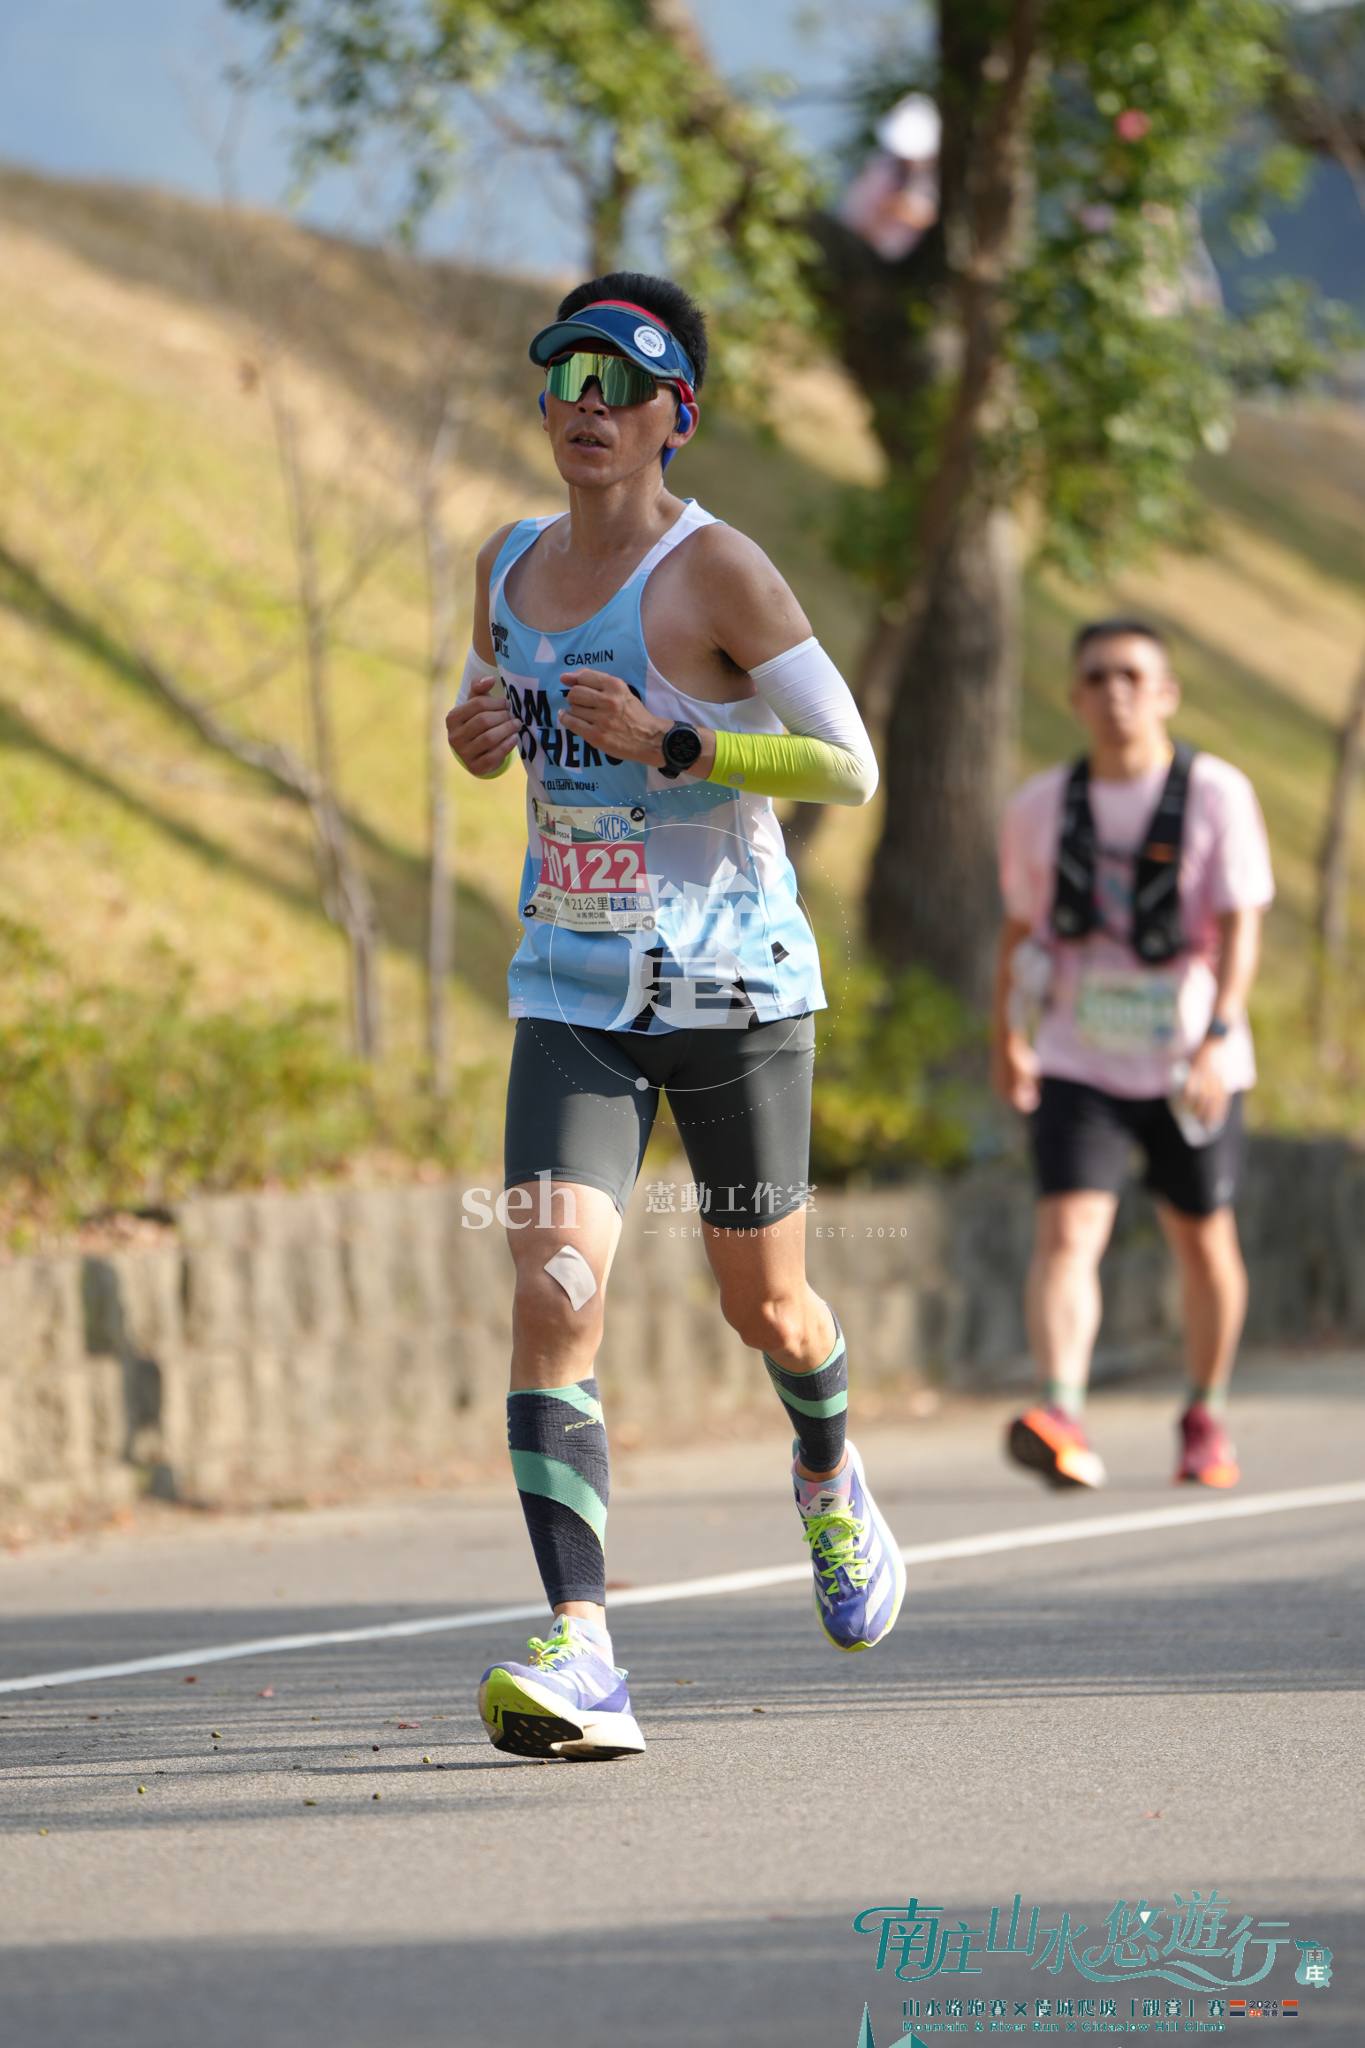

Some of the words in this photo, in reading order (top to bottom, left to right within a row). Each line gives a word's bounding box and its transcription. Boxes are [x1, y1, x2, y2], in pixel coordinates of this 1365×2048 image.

[564, 650, 614, 666] GARMIN
[596, 816, 629, 840] JKCR
[544, 841, 646, 889] 10122
